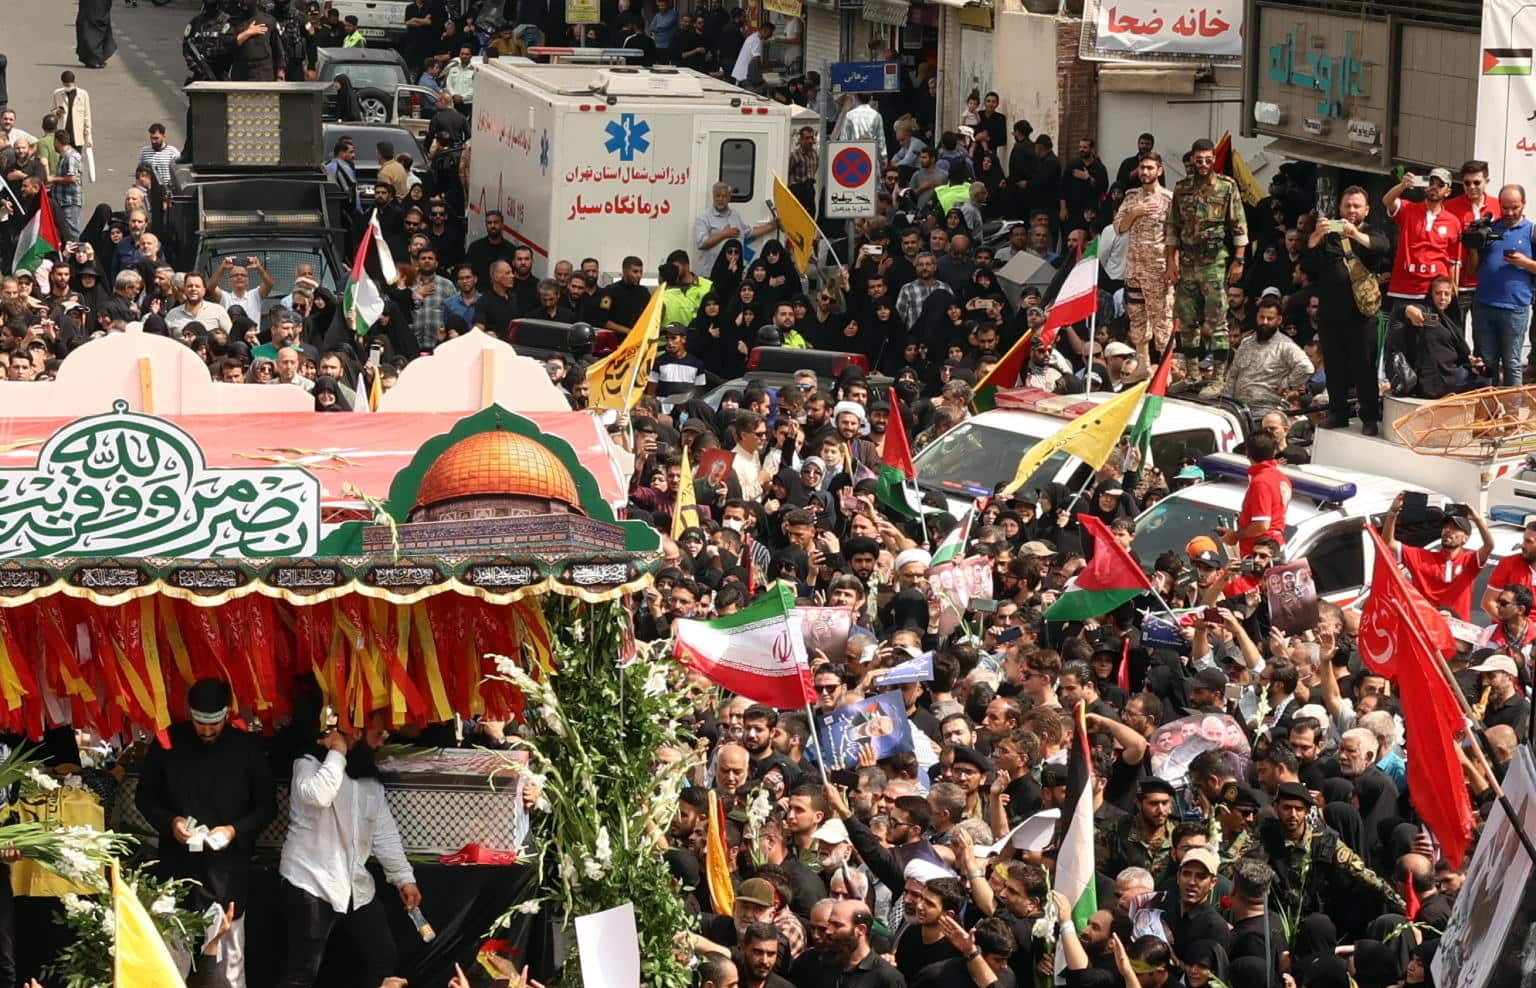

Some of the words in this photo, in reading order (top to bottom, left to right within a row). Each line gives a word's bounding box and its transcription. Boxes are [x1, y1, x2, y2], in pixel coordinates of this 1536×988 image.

[1171, 7, 1230, 38] خانه
[565, 165, 593, 183] تهران
[593, 166, 622, 183] استان
[622, 166, 649, 184] شمال
[648, 165, 690, 185] اورژانس
[566, 194, 603, 221] سیار
[604, 194, 671, 219] درمانگاه
